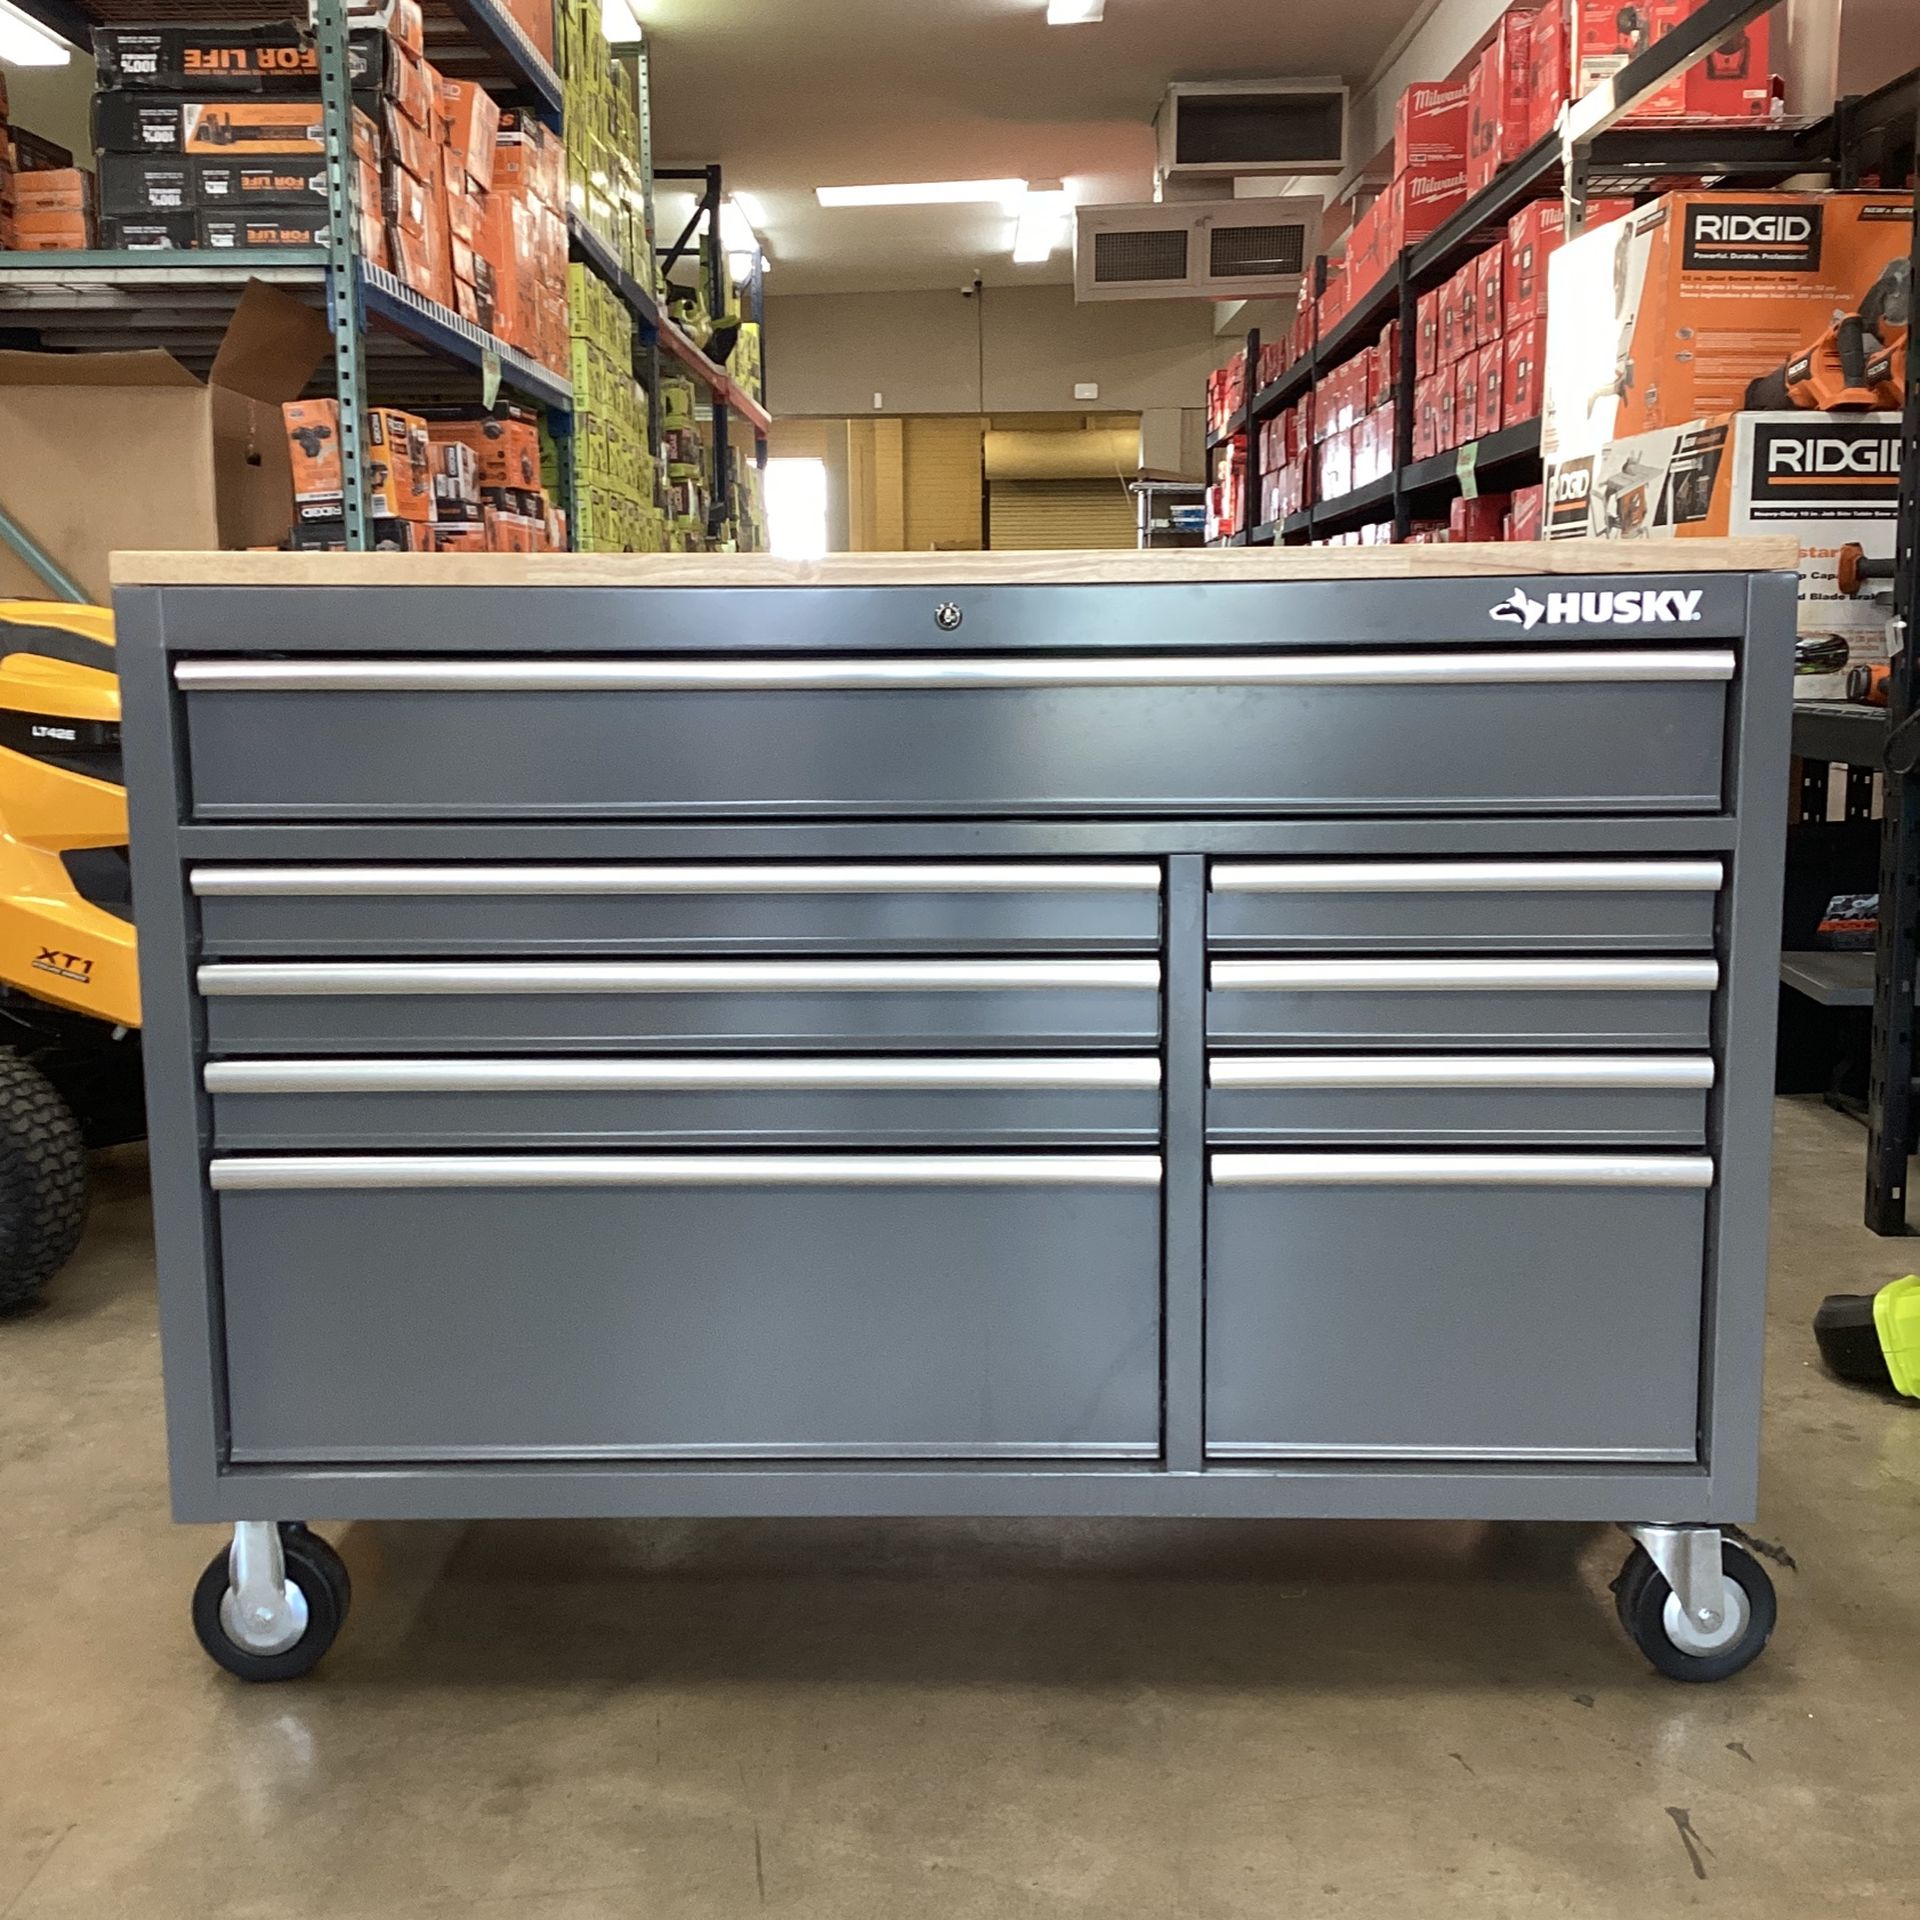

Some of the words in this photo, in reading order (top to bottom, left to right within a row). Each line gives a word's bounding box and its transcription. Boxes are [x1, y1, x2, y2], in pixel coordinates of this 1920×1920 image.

[184, 48, 247, 68] LIFE
[256, 47, 317, 68] FOR
[1413, 84, 1470, 112] Milwauk
[241, 176, 271, 187] LIFE
[274, 176, 304, 187] FOR
[1409, 172, 1467, 198] Milwauk
[247, 229, 277, 240] LIFE
[280, 229, 310, 240] FOR
[1695, 215, 1811, 241] RIDGID
[1799, 547, 1840, 558] star
[1849, 592, 1876, 600] Brak
[1547, 590, 1702, 623] HUSKY
[31, 725, 76, 741] LT42E
[37, 947, 94, 974] XT1
